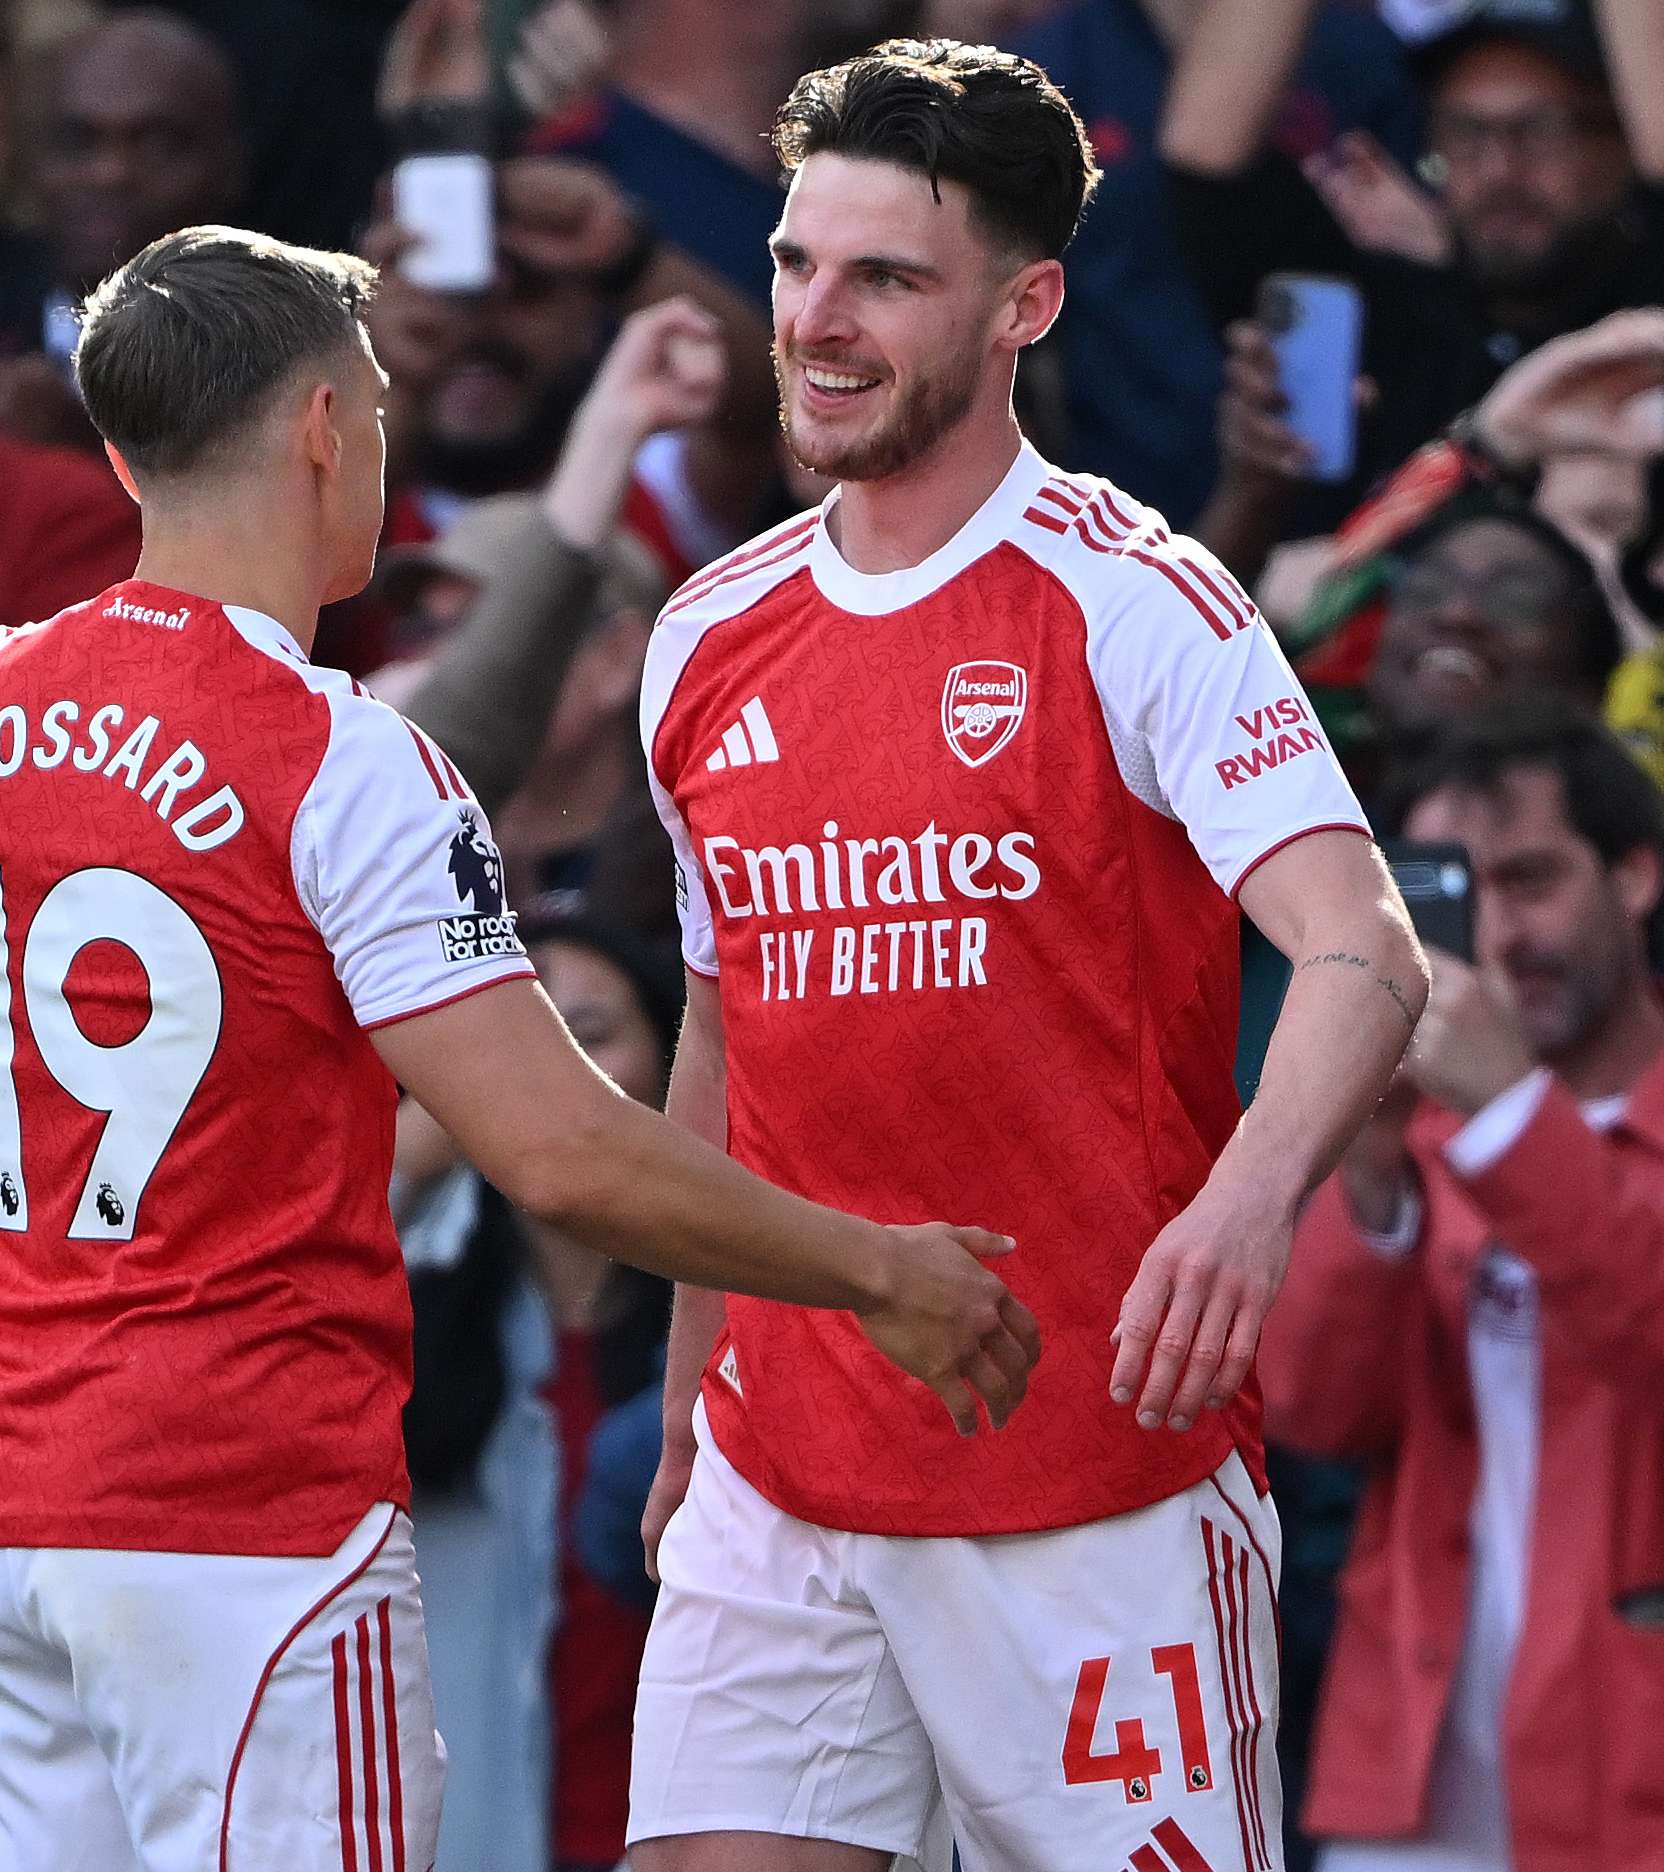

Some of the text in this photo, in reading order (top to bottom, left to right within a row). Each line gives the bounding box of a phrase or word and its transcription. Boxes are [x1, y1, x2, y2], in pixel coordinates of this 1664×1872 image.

[102, 596, 191, 631] Arsenal
[955, 679, 1015, 697] Arsenal
[703, 818, 1042, 919] Emirates
[439, 917, 476, 940] No
[444, 939, 477, 961] for
[759, 917, 988, 1001] FLY BETTER
[1061, 1640, 1215, 1805] 41
